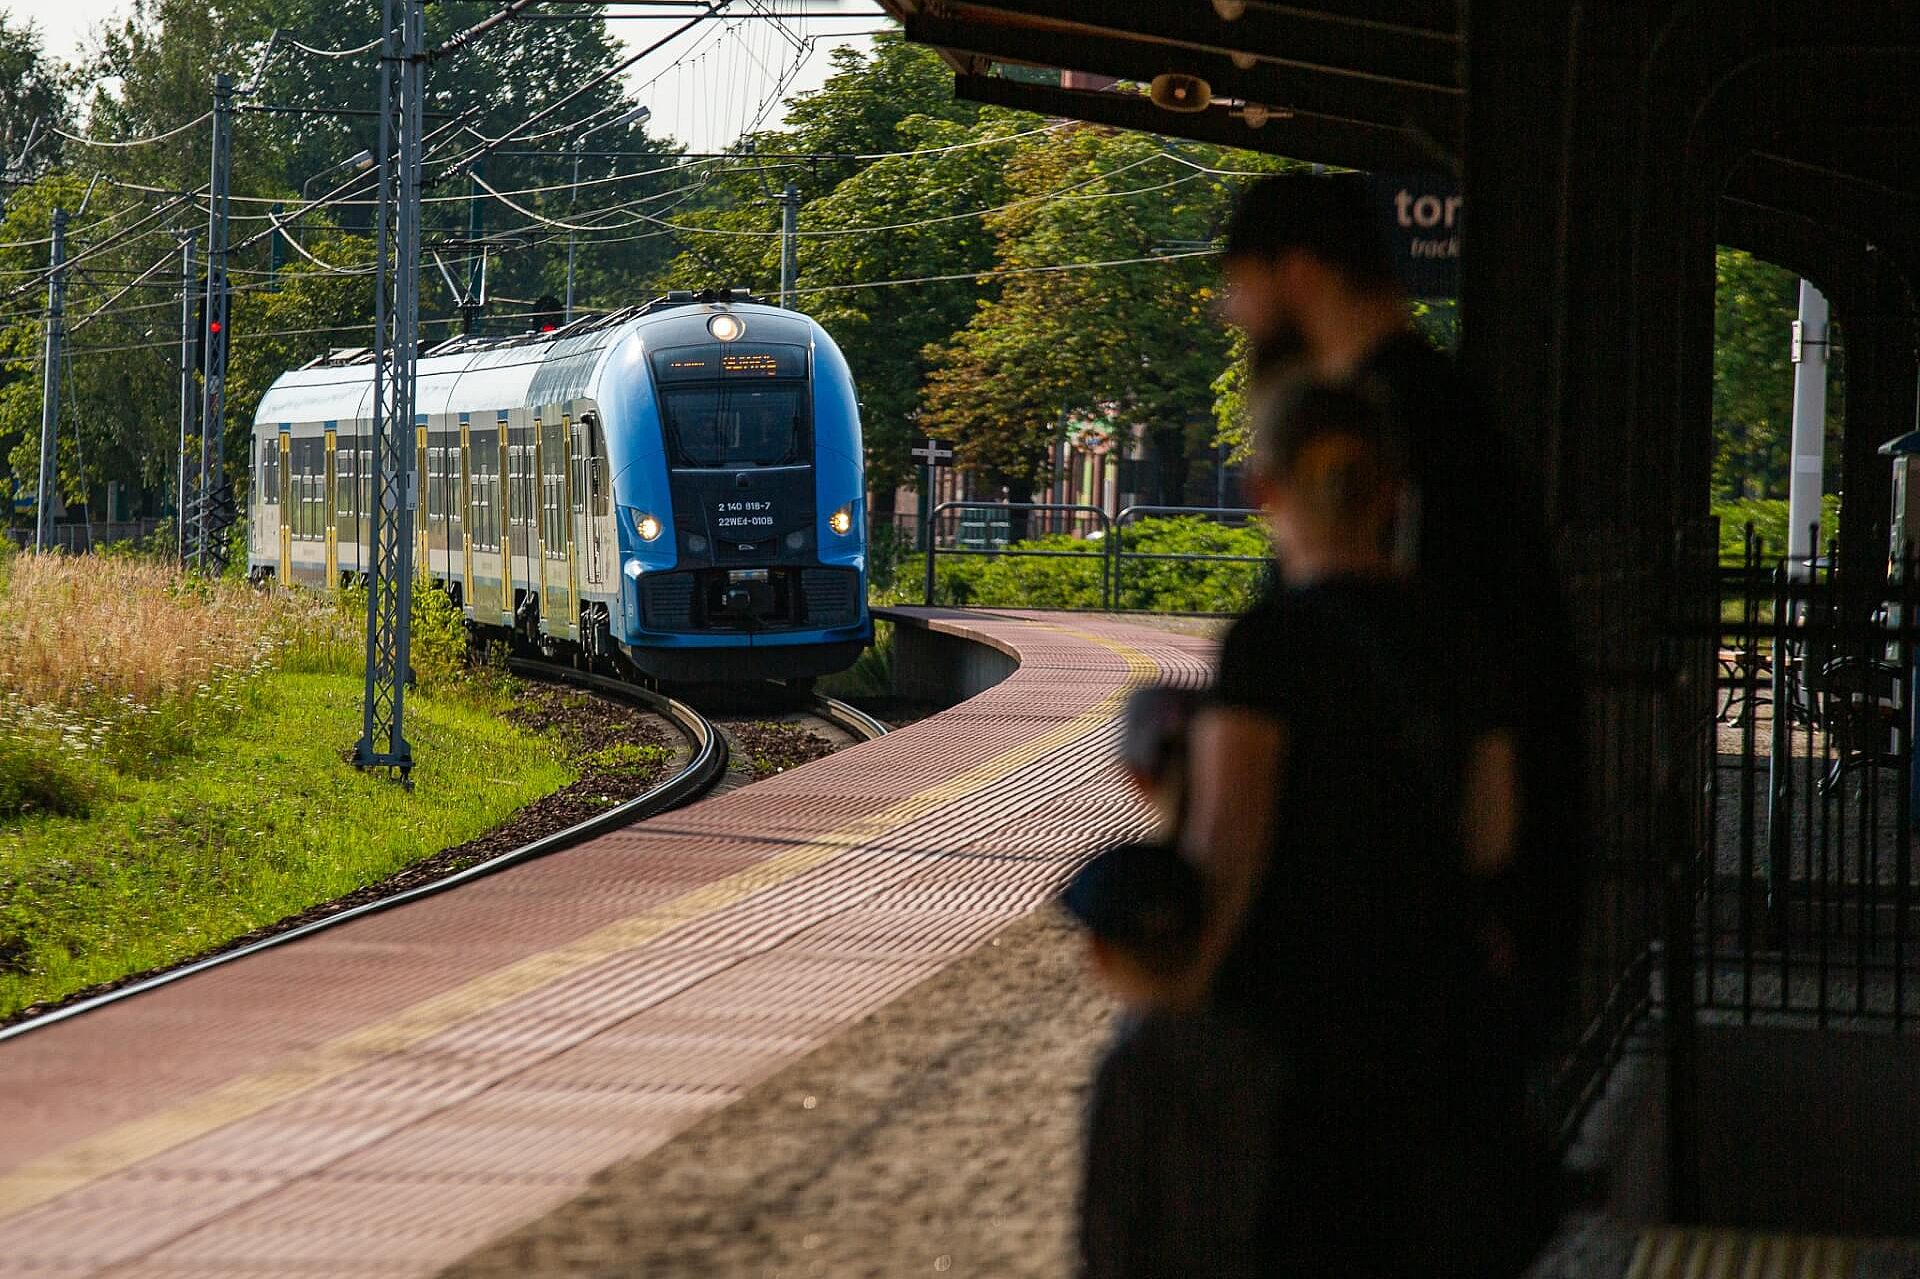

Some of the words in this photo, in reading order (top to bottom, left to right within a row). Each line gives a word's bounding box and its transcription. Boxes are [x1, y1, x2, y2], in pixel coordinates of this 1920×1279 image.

[1394, 188, 1464, 229] tor
[718, 503, 725, 512] 2
[727, 502, 743, 511] 140
